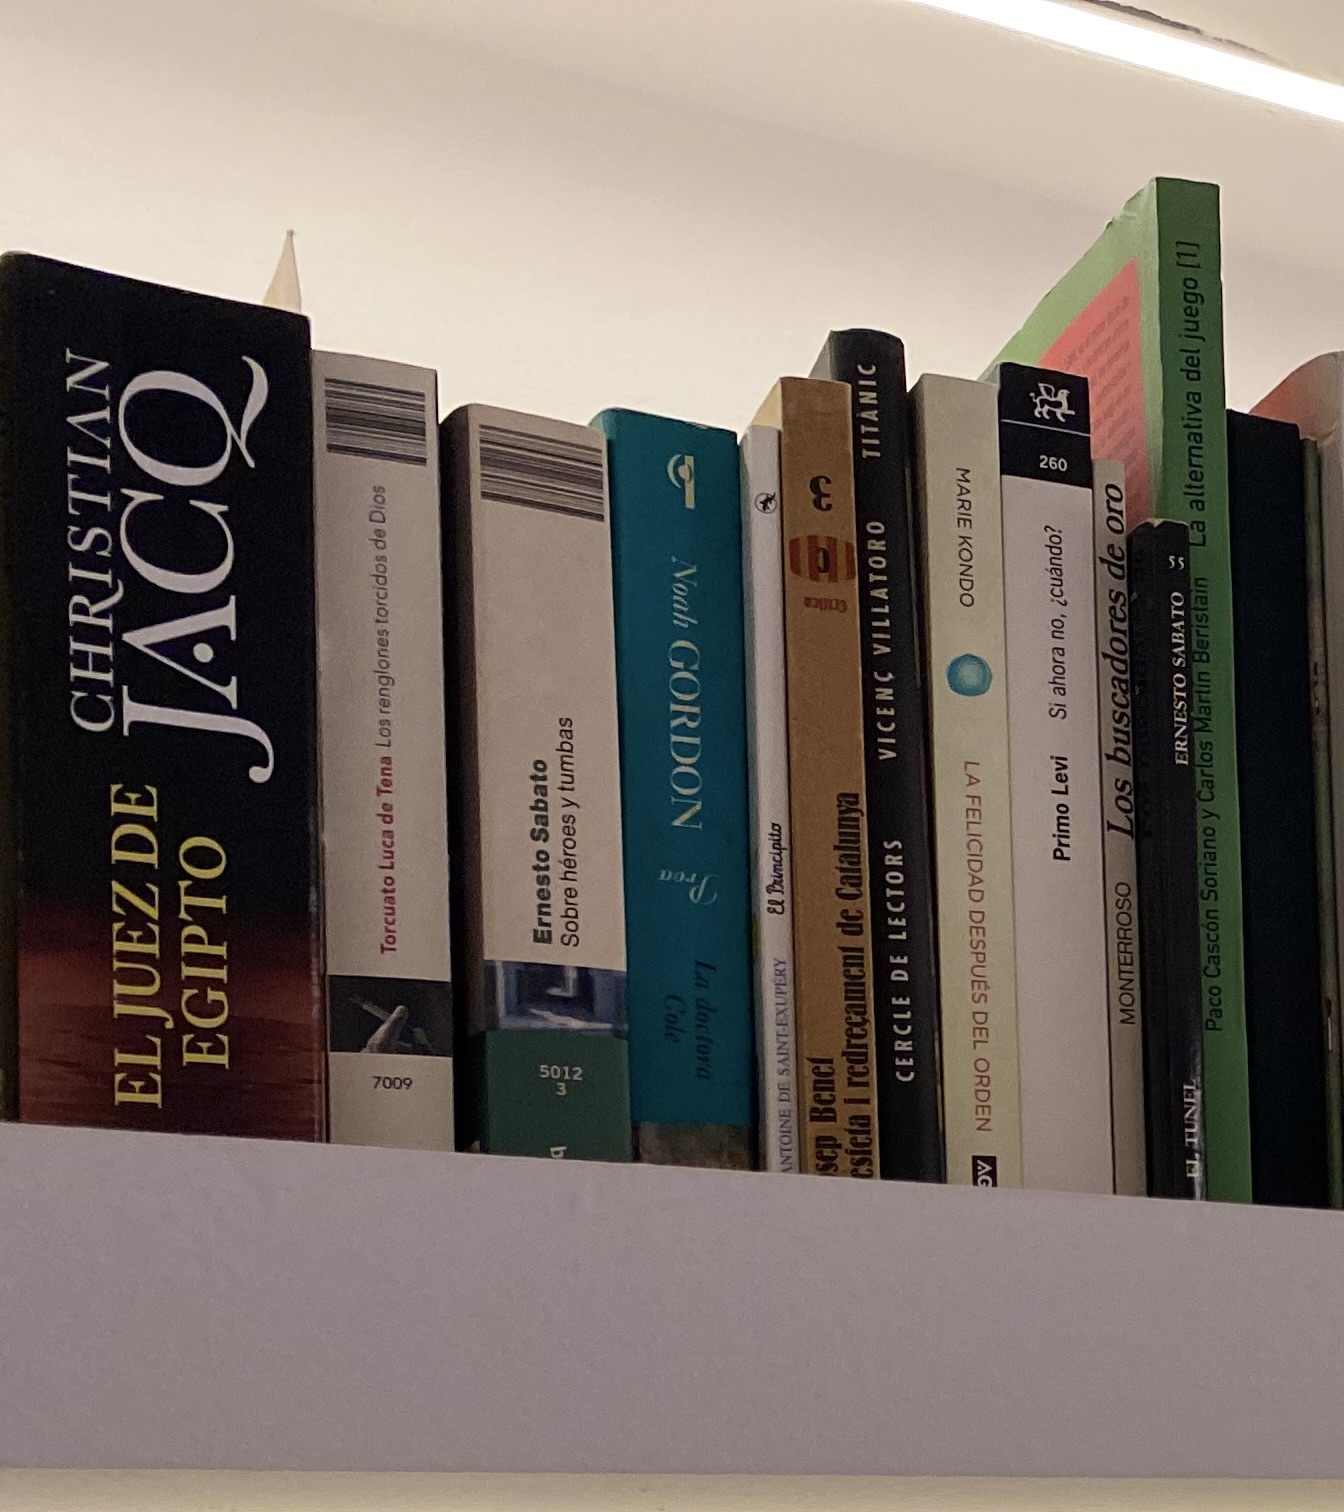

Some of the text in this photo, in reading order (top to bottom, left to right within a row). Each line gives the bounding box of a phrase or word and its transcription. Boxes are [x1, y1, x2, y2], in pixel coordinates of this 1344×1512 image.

[1039, 456, 1069, 472] 260
[1175, 240, 1207, 547] La alternativa del juego [1]
[65, 347, 125, 733] CHRISTIAN
[118, 357, 274, 784] JACQ
[866, 521, 891, 655] VILLATORO
[955, 467, 974, 607] MARIE KONDO
[368, 485, 396, 954] Torcuato Luca de Tena Los renglones torcidos de Dios
[1047, 646, 1066, 696] ahora
[1048, 703, 1066, 719] Si
[1097, 481, 1134, 837] Los buscadores de oro
[529, 759, 552, 944] Ernesto Sabato
[555, 717, 580, 946] Sobre héroes y tumbas
[765, 822, 788, 914] El Principito
[1049, 755, 1070, 861] Primo Levi
[109, 783, 174, 1108] EL JUEZ DE
[177, 836, 229, 1069] EGIPTO
[1114, 881, 1135, 1024] MONTERROSO
[372, 1076, 414, 1093] 7009
[540, 1064, 584, 1080] 5012
